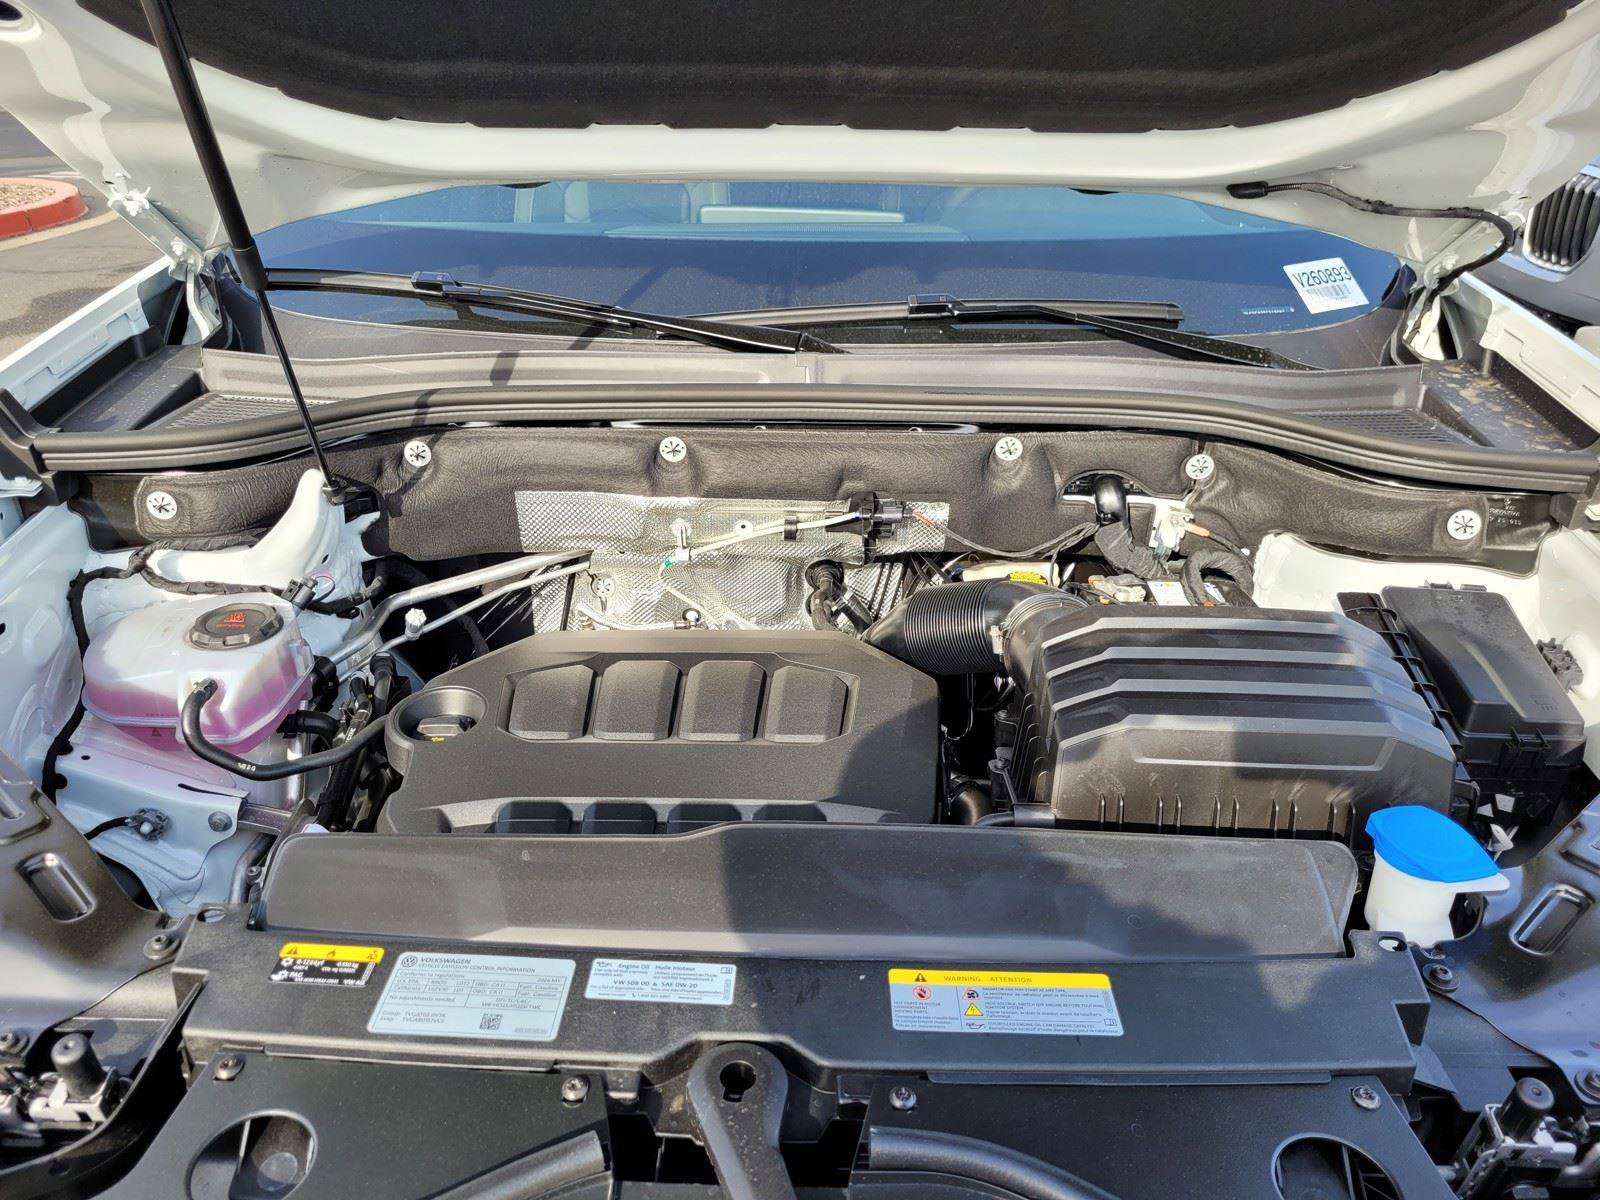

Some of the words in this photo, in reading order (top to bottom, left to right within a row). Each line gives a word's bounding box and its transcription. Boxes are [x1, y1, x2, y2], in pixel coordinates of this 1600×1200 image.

[1292, 266, 1352, 288] V260893
[420, 957, 472, 965] VOLKSWAGEN
[990, 976, 1032, 984] ATTENTION
